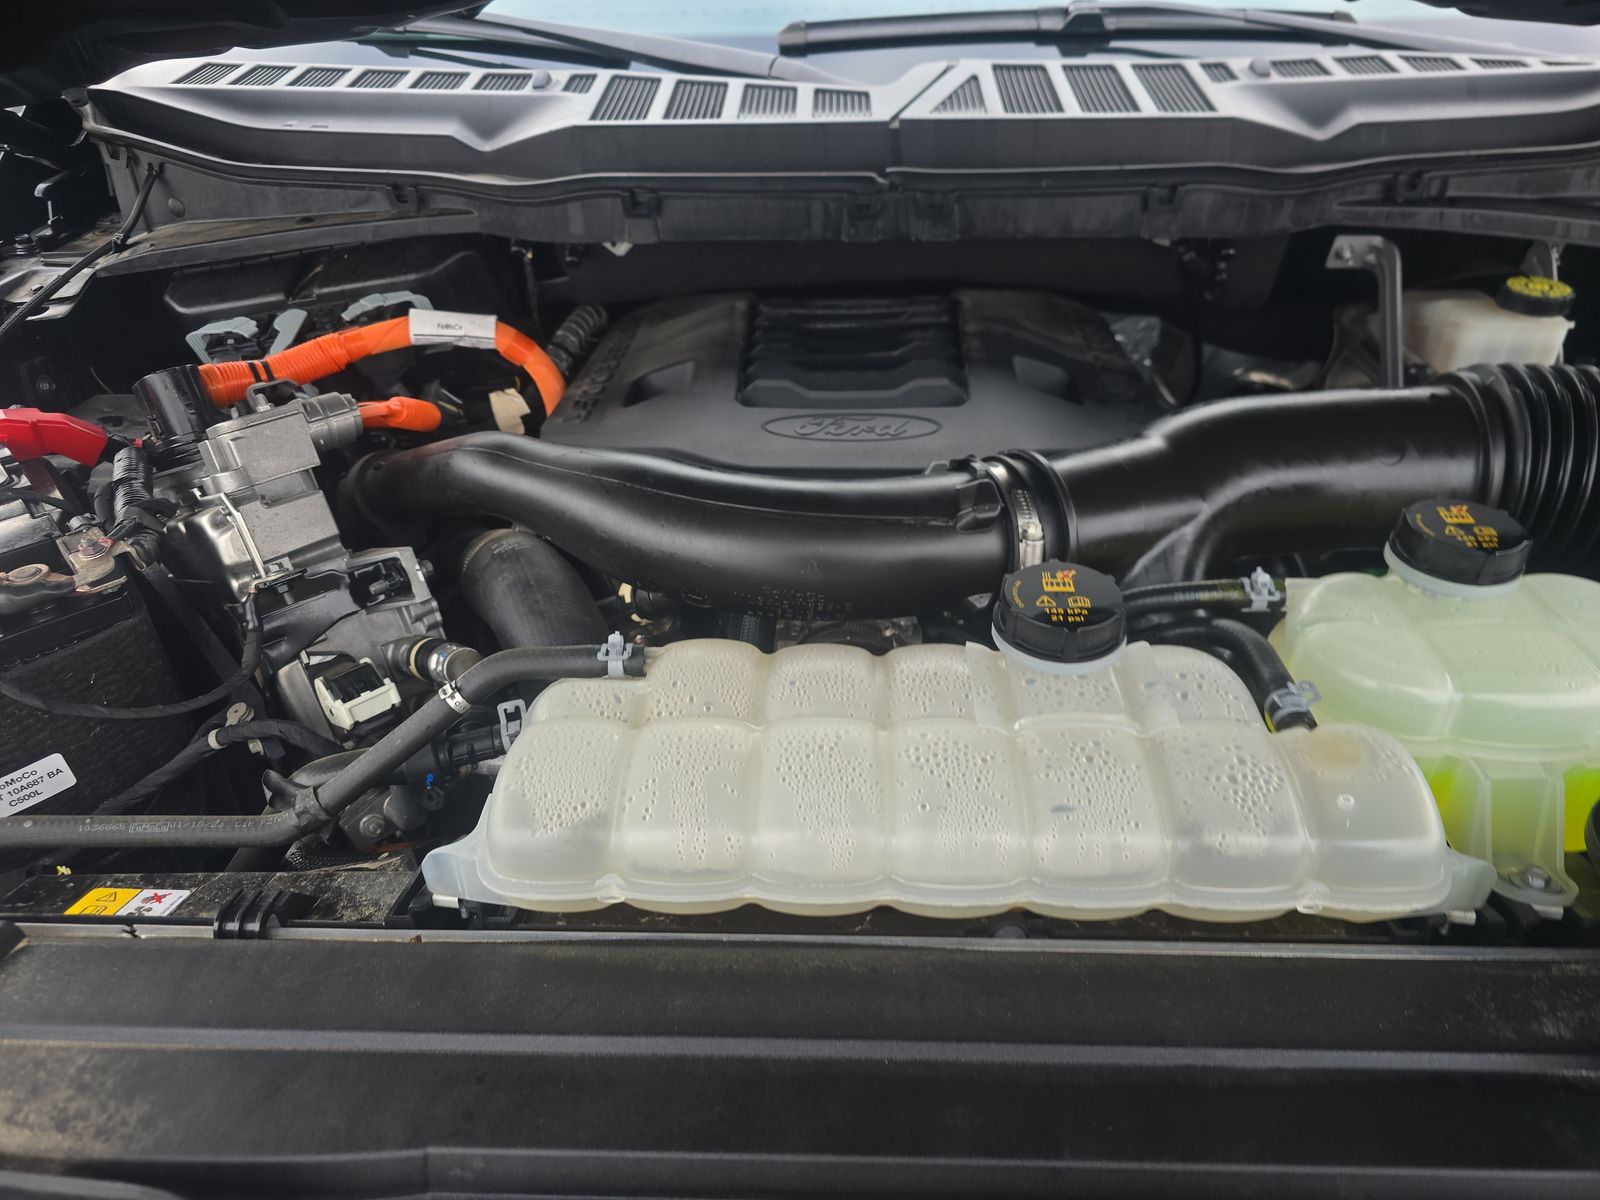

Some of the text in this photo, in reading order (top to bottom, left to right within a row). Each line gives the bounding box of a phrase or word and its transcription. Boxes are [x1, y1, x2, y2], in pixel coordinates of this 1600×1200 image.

[437, 323, 463, 331] FoMoCo
[794, 416, 911, 437] Ford
[7, 775, 44, 797] 10A687
[47, 768, 64, 779] BA
[9, 789, 44, 807] C500L
